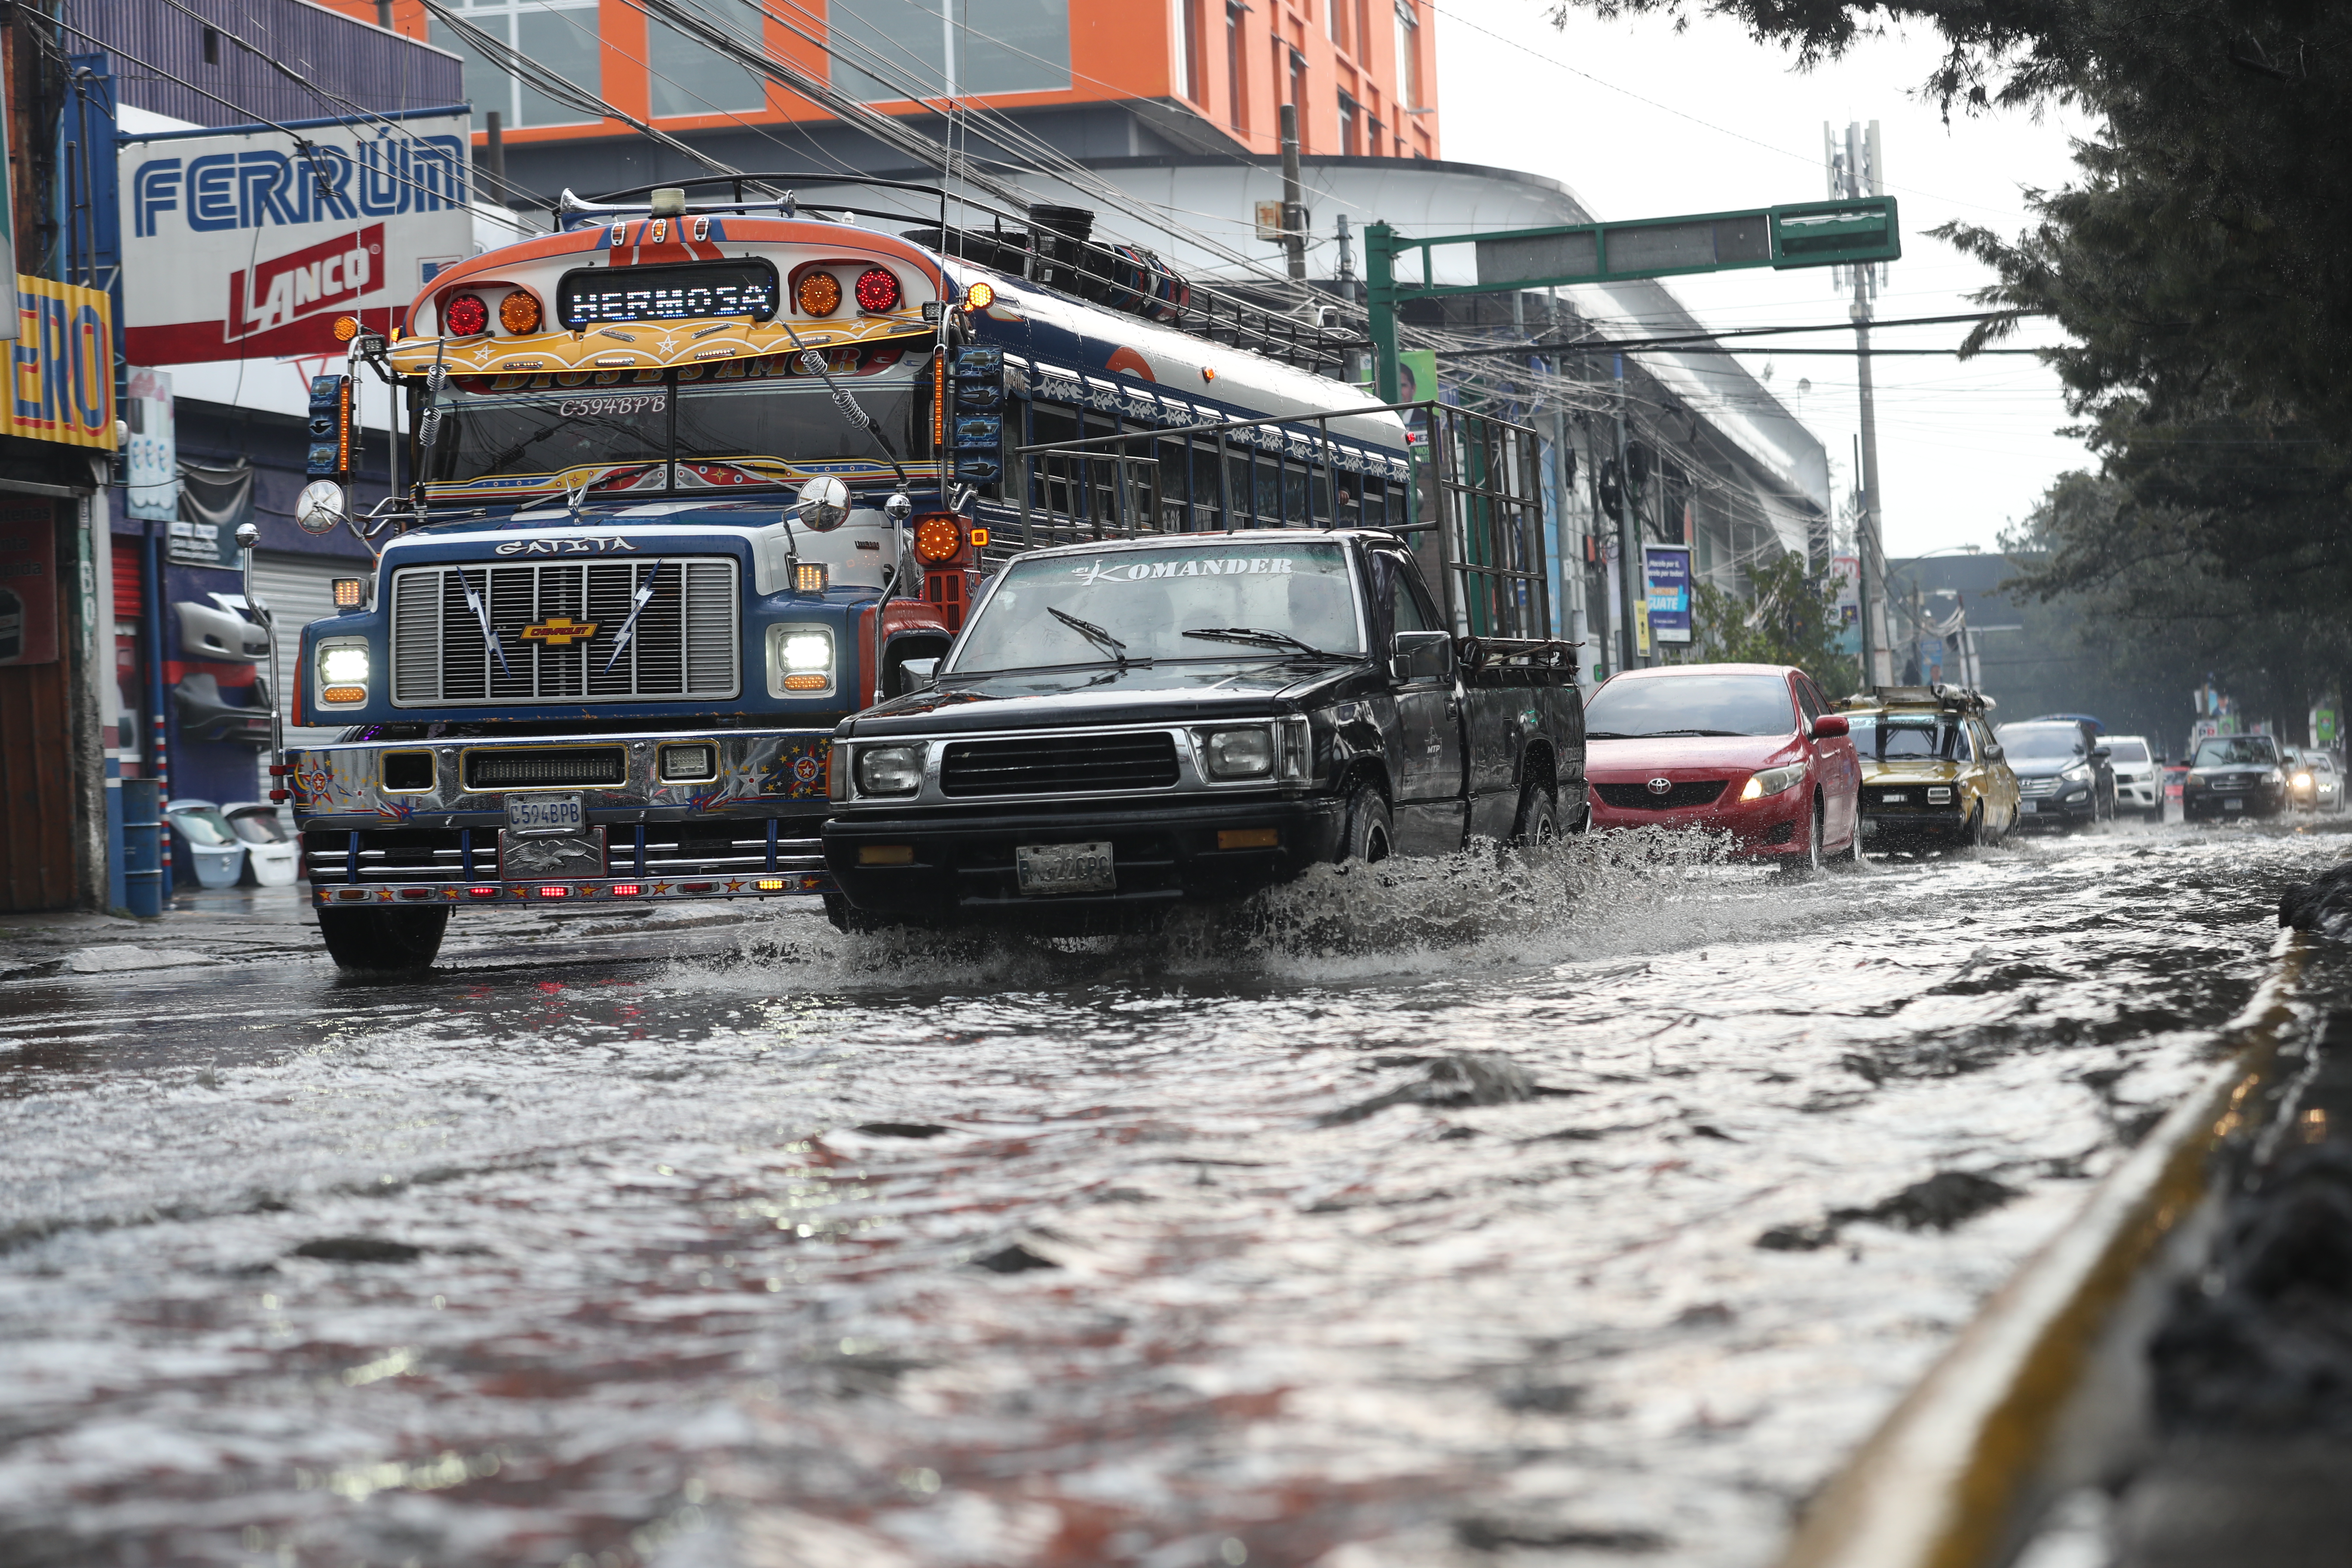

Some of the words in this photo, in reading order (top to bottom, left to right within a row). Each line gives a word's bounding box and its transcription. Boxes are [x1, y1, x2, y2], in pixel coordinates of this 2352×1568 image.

[242, 248, 370, 333] LANCO
[491, 370, 621, 390] DIOS
[715, 347, 861, 378] AMOR
[495, 536, 637, 555] GATITA
[1075, 558, 1293, 586] KOMANDER
[531, 627, 589, 636] CHEVROLET
[1427, 744, 1440, 754] MTP
[510, 803, 579, 824] C594BPB
